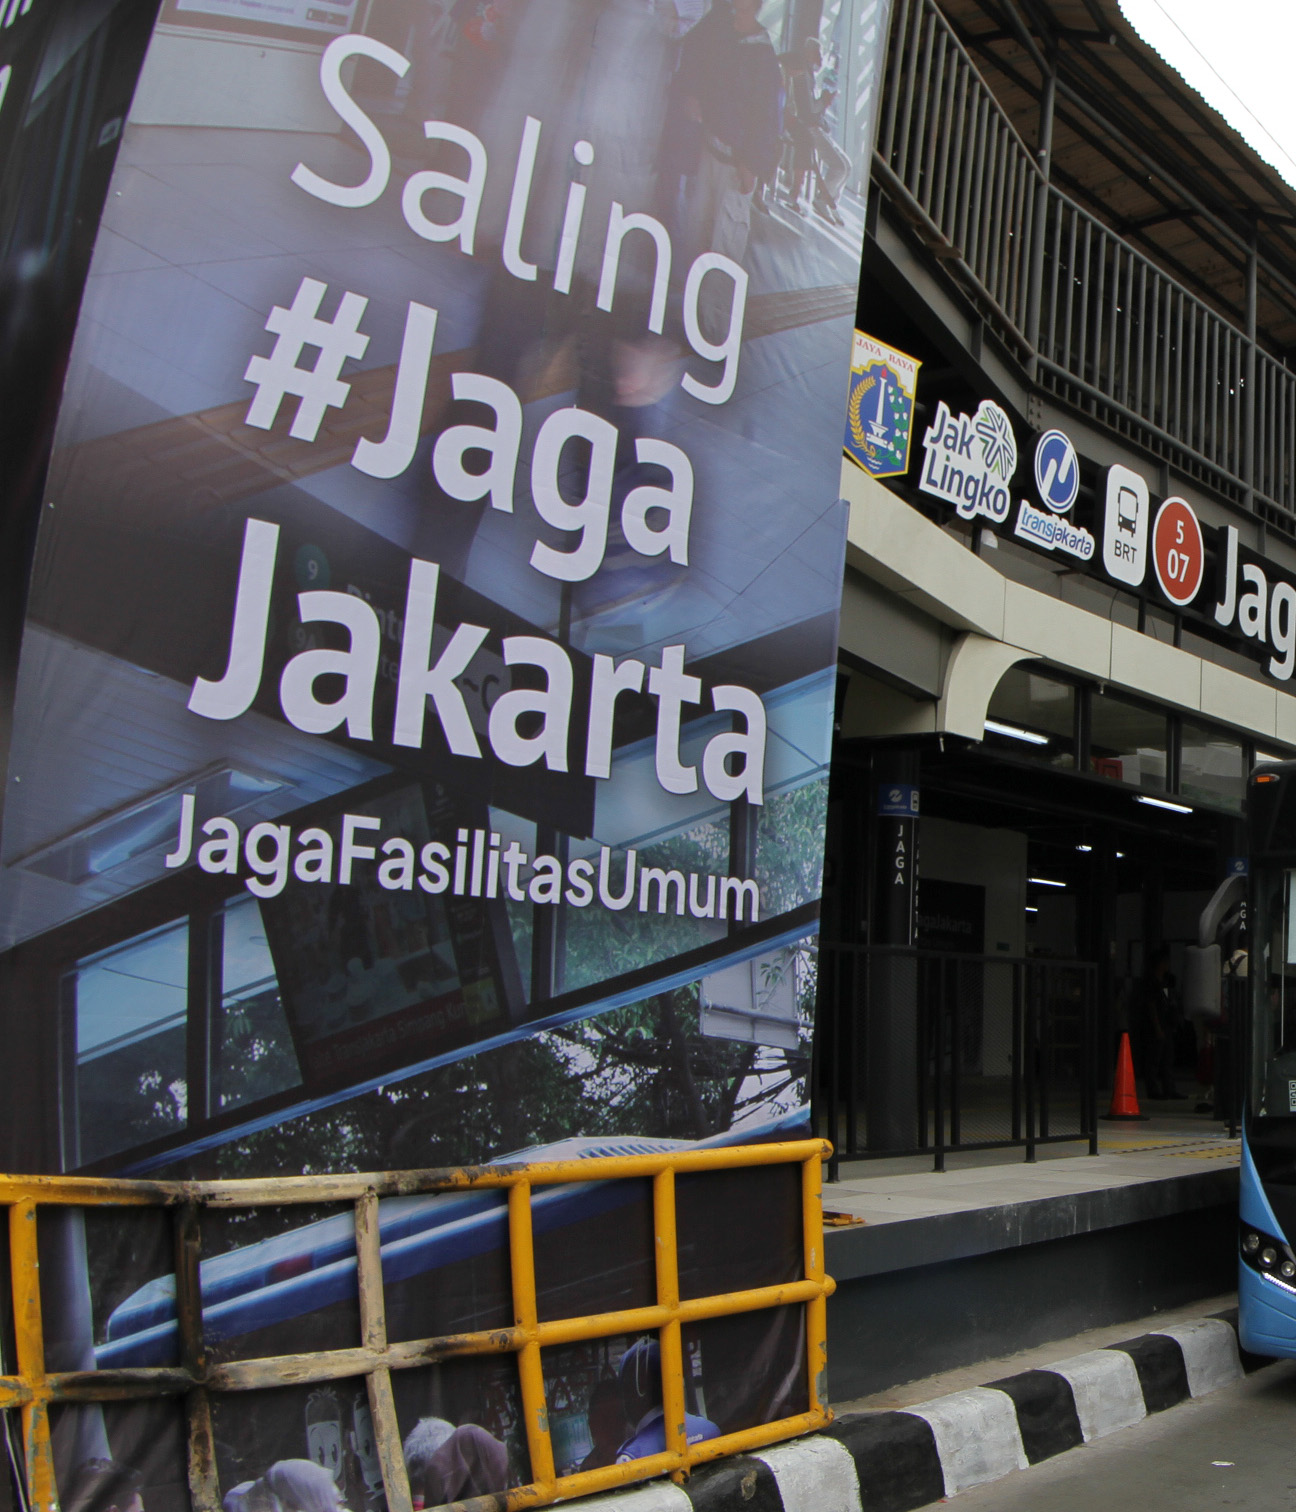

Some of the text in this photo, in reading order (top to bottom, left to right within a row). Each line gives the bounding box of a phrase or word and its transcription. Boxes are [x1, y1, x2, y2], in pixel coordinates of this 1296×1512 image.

[291, 34, 749, 405] Saling
[856, 339, 914, 373] JAYA RAYA
[243, 277, 695, 582] #Jaga
[929, 410, 975, 460] Jak
[925, 448, 1007, 516] Lingko
[1021, 507, 1092, 556] transjakarta
[1114, 539, 1137, 565] BRT
[1175, 519, 1185, 545] 5
[1167, 548, 1190, 583] 07
[187, 518, 767, 806] Jakarta
[165, 794, 760, 923] JagaFasilitasUmum
[894, 824, 906, 886] JAGA
